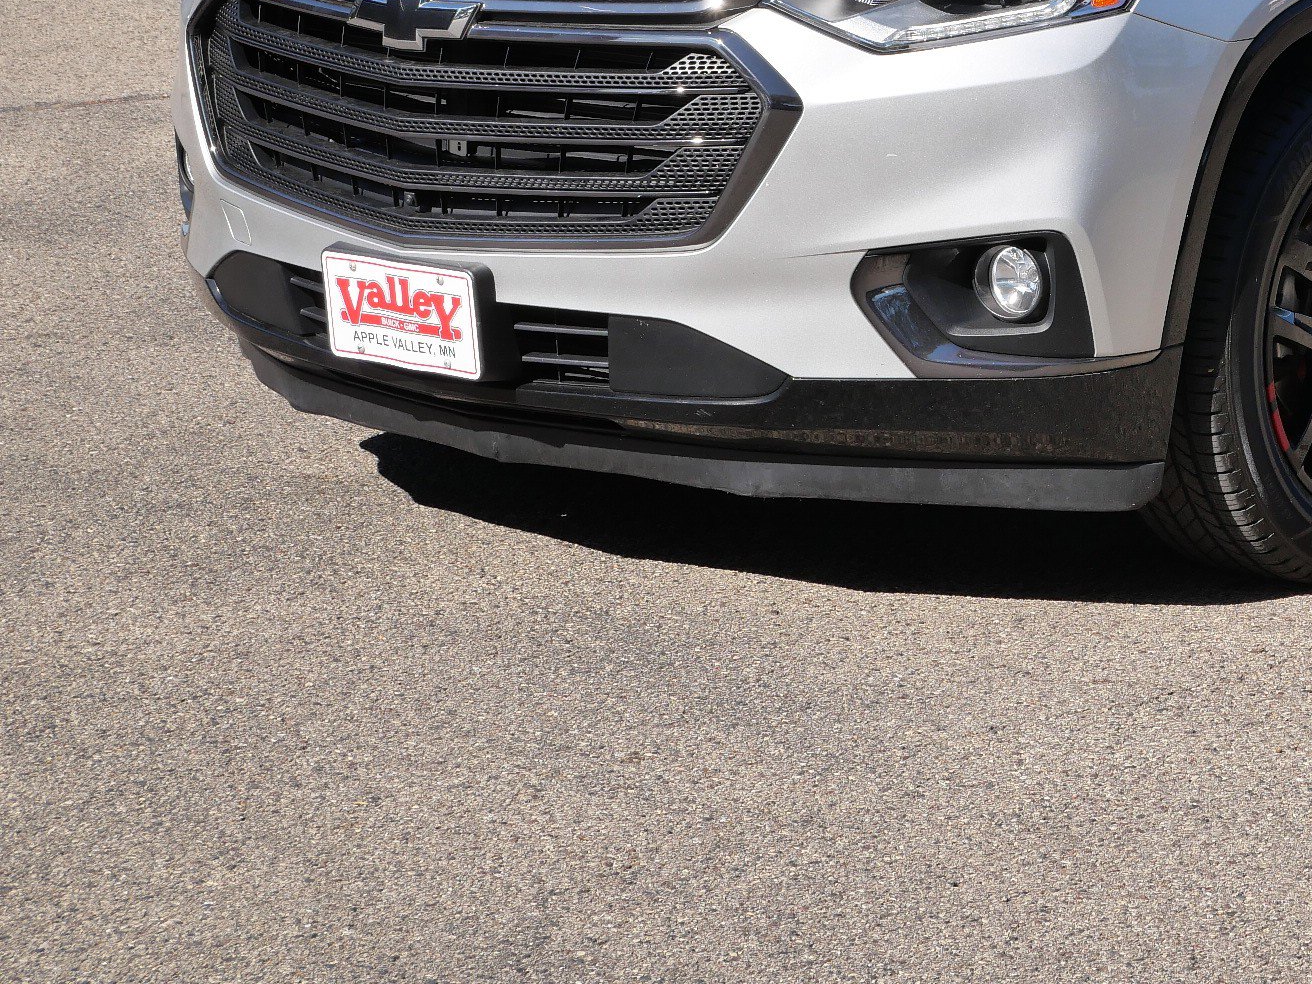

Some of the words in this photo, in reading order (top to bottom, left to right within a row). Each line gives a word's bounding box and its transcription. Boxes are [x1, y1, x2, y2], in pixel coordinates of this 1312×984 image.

[381, 316, 401, 330] BUICK
[403, 321, 420, 333] GMC
[353, 330, 390, 347] APPLE
[391, 336, 436, 356] VALLEY,
[438, 344, 456, 359] MN
